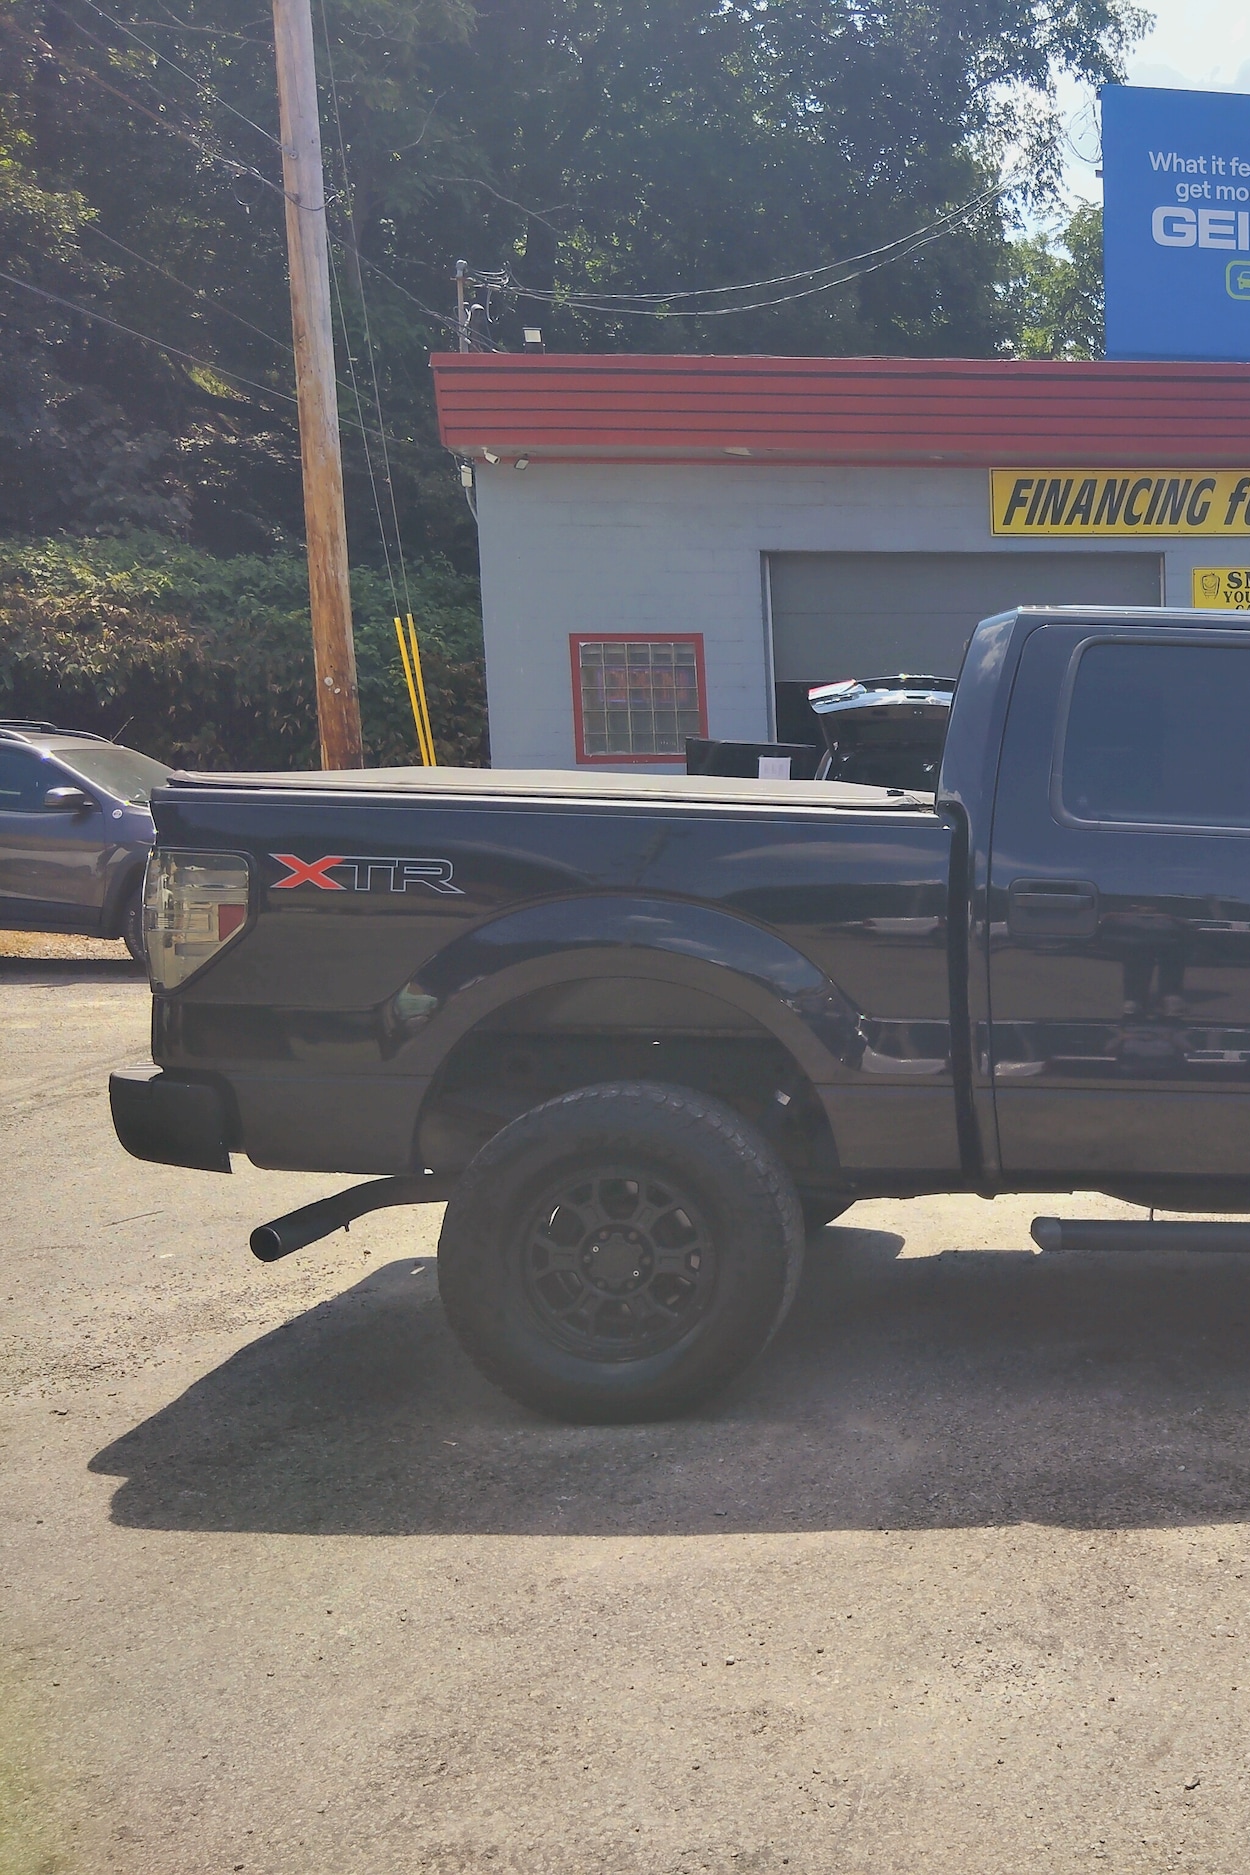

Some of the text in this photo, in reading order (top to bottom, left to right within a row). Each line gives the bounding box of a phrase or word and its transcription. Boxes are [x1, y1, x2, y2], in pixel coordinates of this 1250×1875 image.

[1148, 151, 1207, 174] What
[1211, 155, 1226, 176] it
[1175, 180, 1211, 203] get
[1002, 477, 1217, 526] FINANCING
[268, 853, 465, 894] XTR
